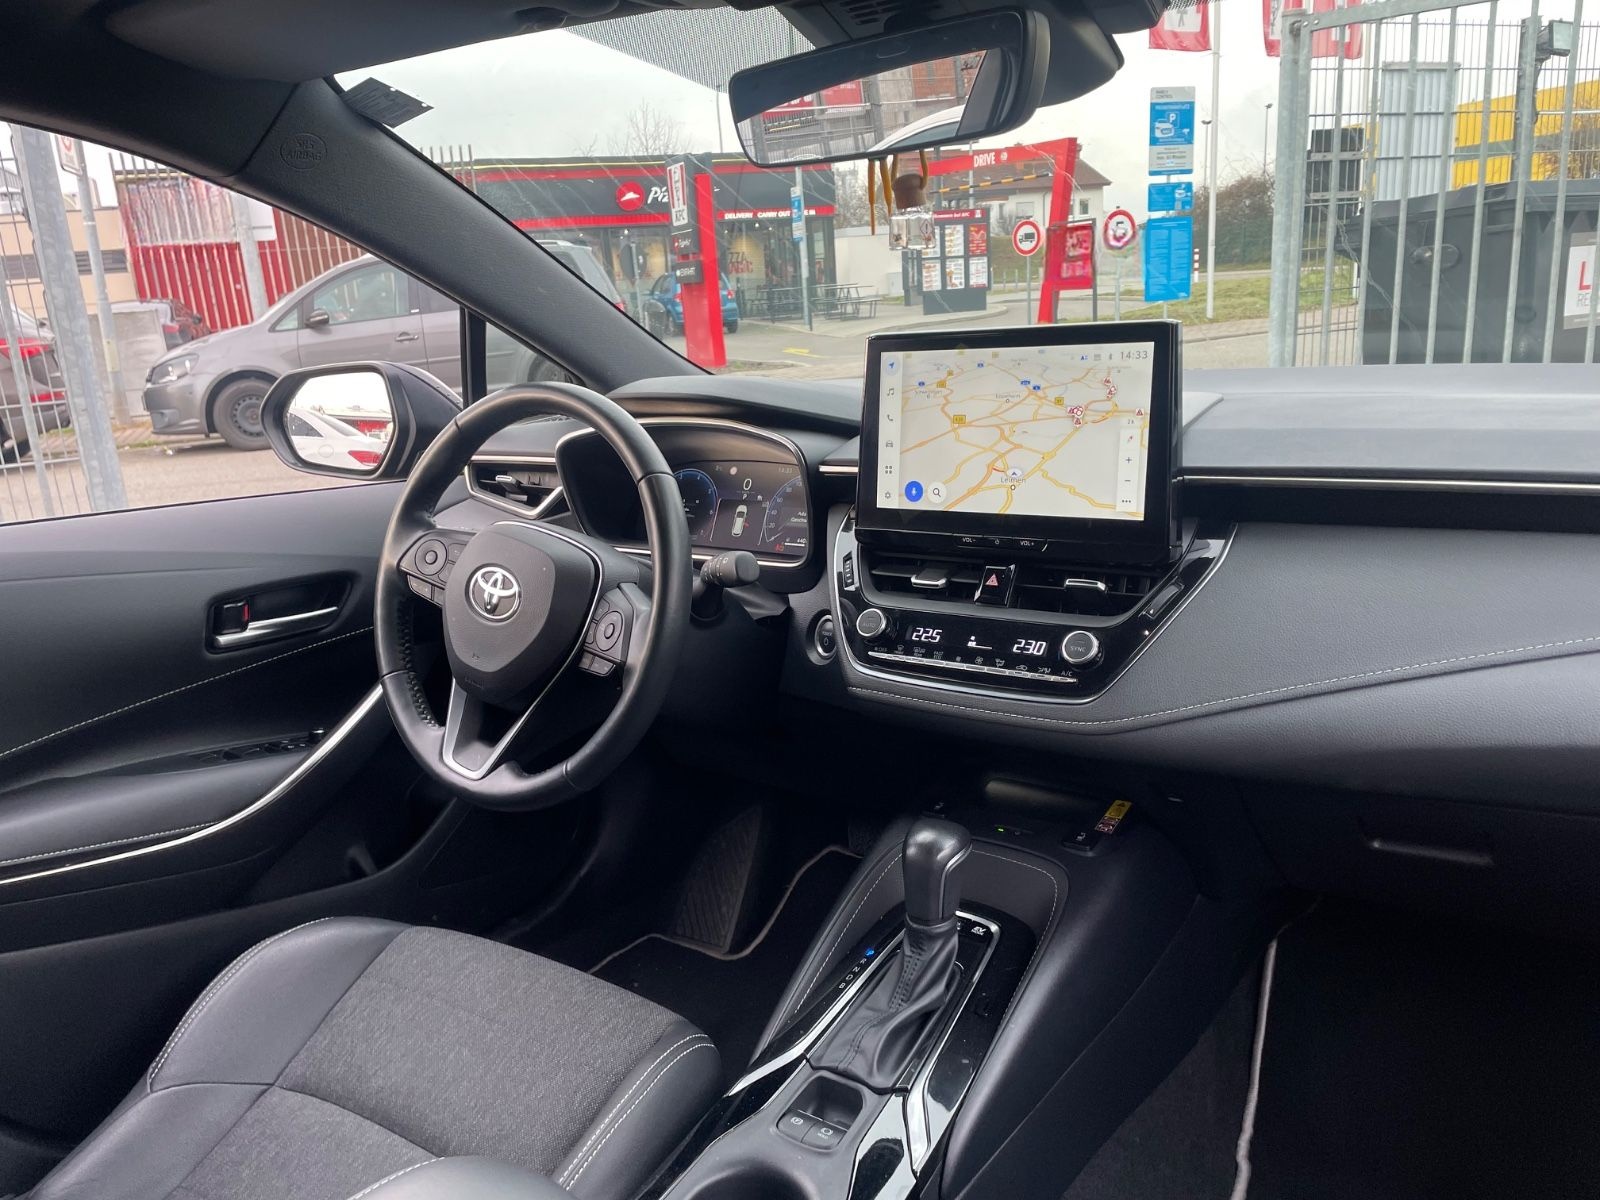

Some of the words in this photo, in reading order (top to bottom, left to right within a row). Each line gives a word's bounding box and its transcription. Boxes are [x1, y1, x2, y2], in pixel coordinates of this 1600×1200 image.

[973, 151, 996, 168] DRIVE
[647, 186, 669, 204] Piz
[724, 211, 754, 220] DELIVERY
[757, 210, 777, 218] CARRY
[778, 209, 791, 217] OUT
[1120, 350, 1148, 360] 14:33
[743, 478, 752, 491] 0
[1000, 477, 1027, 485] Leimen
